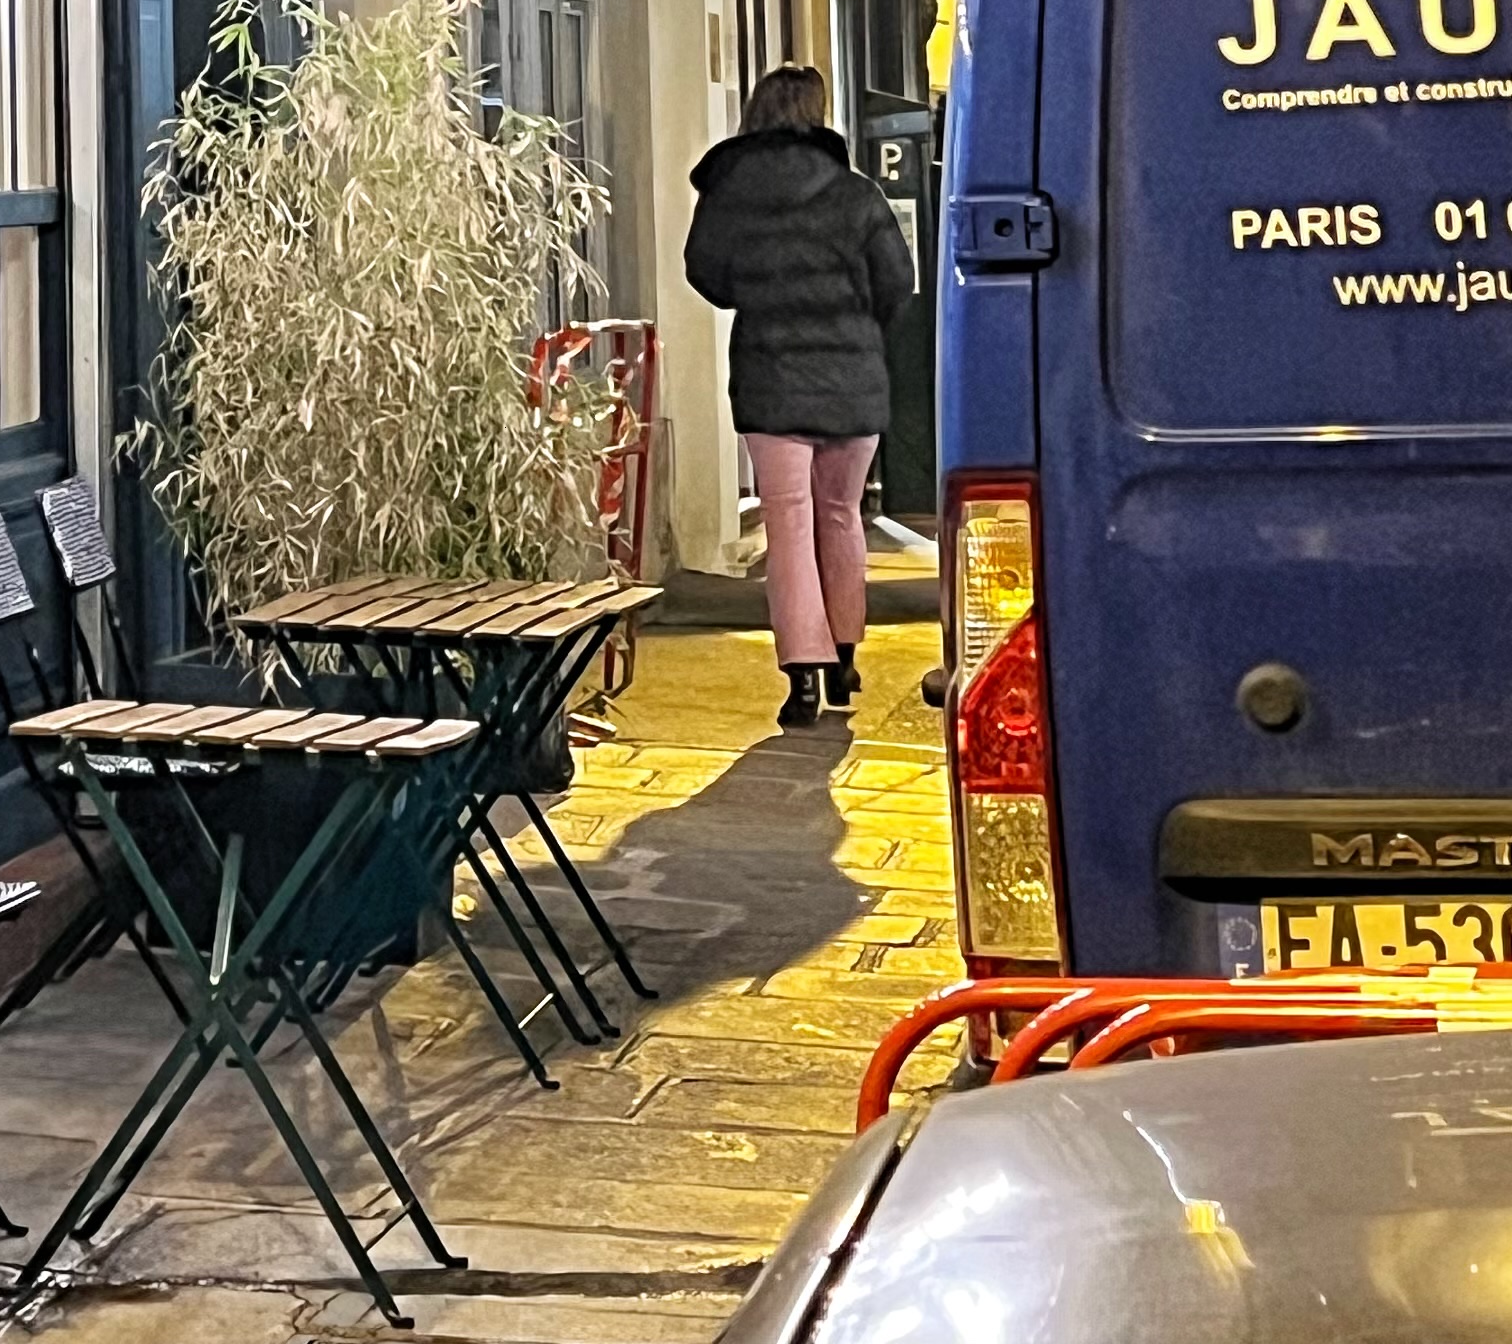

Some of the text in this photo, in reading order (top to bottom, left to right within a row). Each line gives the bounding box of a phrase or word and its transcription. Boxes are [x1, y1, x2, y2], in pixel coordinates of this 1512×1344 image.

[1222, 84, 1377, 111] Comprendre
[1384, 81, 1410, 102] et
[880, 143, 903, 179] P
[1232, 205, 1382, 249] PARIS
[1434, 199, 1487, 241] 01
[1311, 833, 1512, 867] MAST
